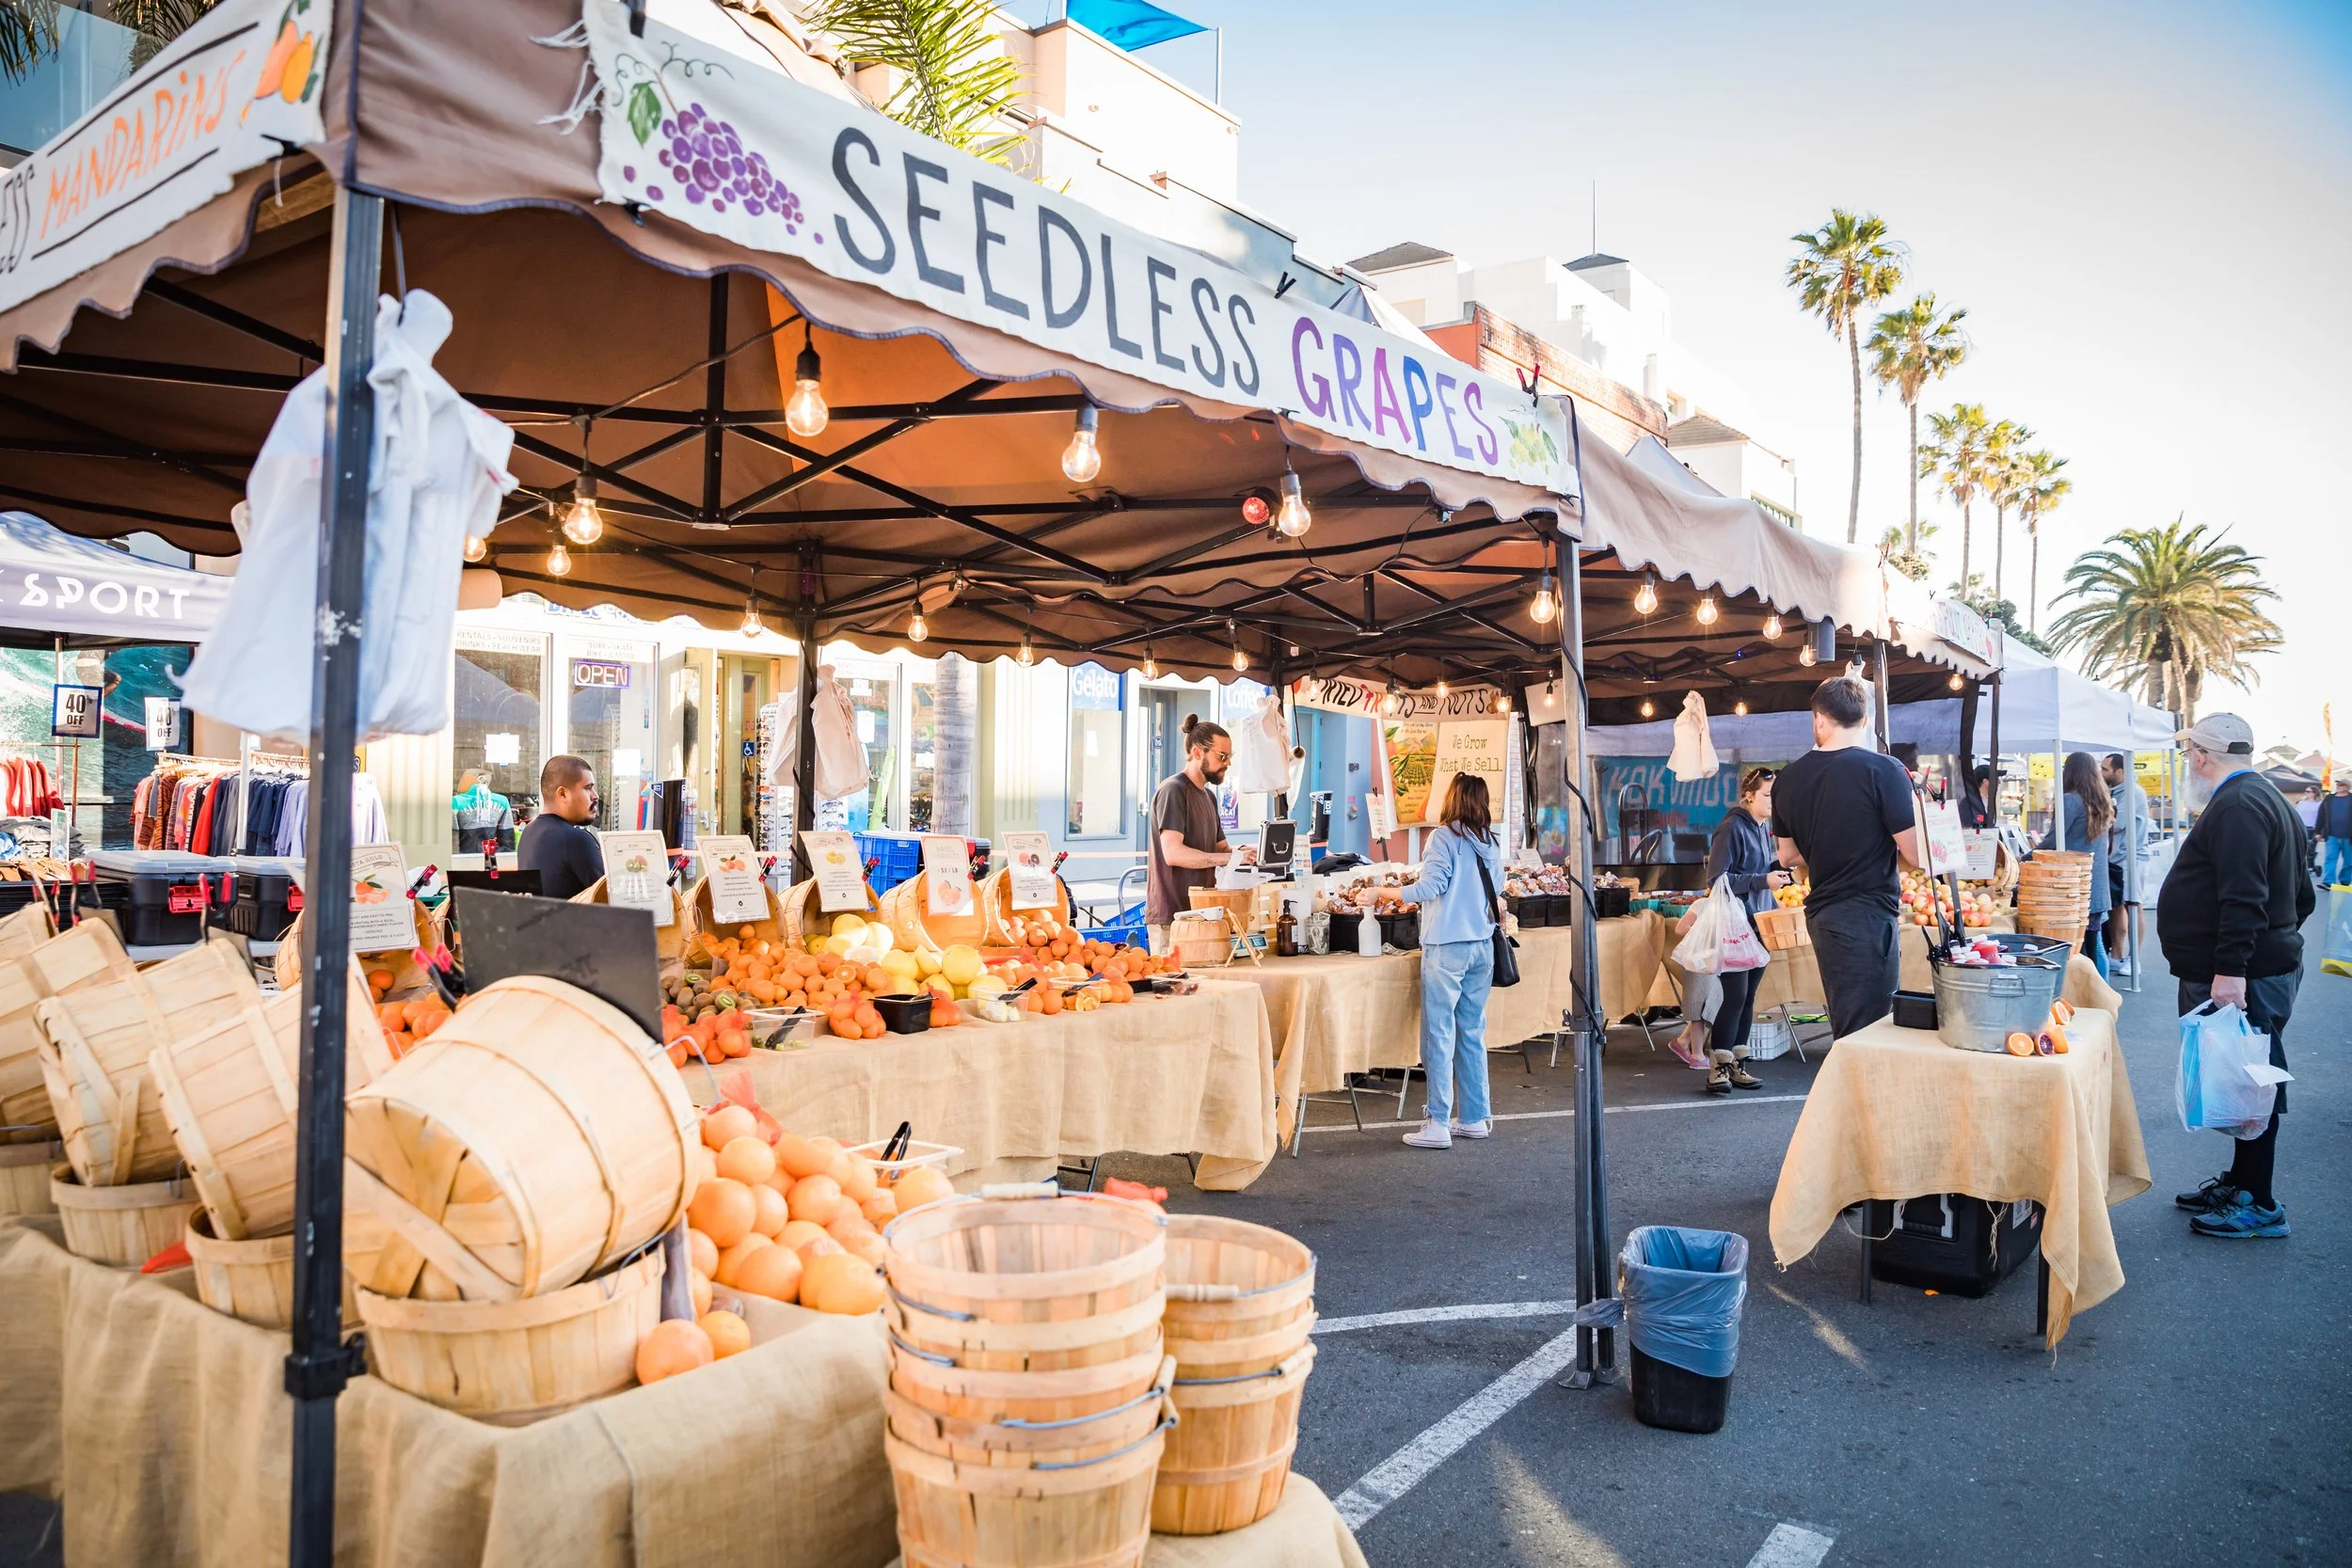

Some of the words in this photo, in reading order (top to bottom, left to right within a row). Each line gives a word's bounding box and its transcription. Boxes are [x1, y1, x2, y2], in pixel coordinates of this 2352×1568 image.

[40, 49, 246, 241] MANDARINS
[832, 126, 1261, 398] SEEDLESS
[1291, 315, 1500, 467] GRAPES
[19, 573, 190, 620] SPORT
[455, 640, 486, 649] DRINKS
[456, 630, 491, 641] RENTALS
[498, 634, 541, 645] SOUVENIRS
[578, 663, 628, 687] OPEN
[1073, 668, 1118, 698] Gelato
[1361, 685, 1416, 719] FRTS
[1420, 696, 1438, 710] AND
[1439, 689, 1488, 715] NUTS
[67, 714, 85, 726] OFF
[1453, 735, 1462, 750] We
[1464, 734, 1487, 750] Grow
[1439, 757, 1458, 772] What
[1461, 757, 1472, 772] We
[1474, 757, 1503, 772] Sell
[365, 854, 384, 863] GOLD
